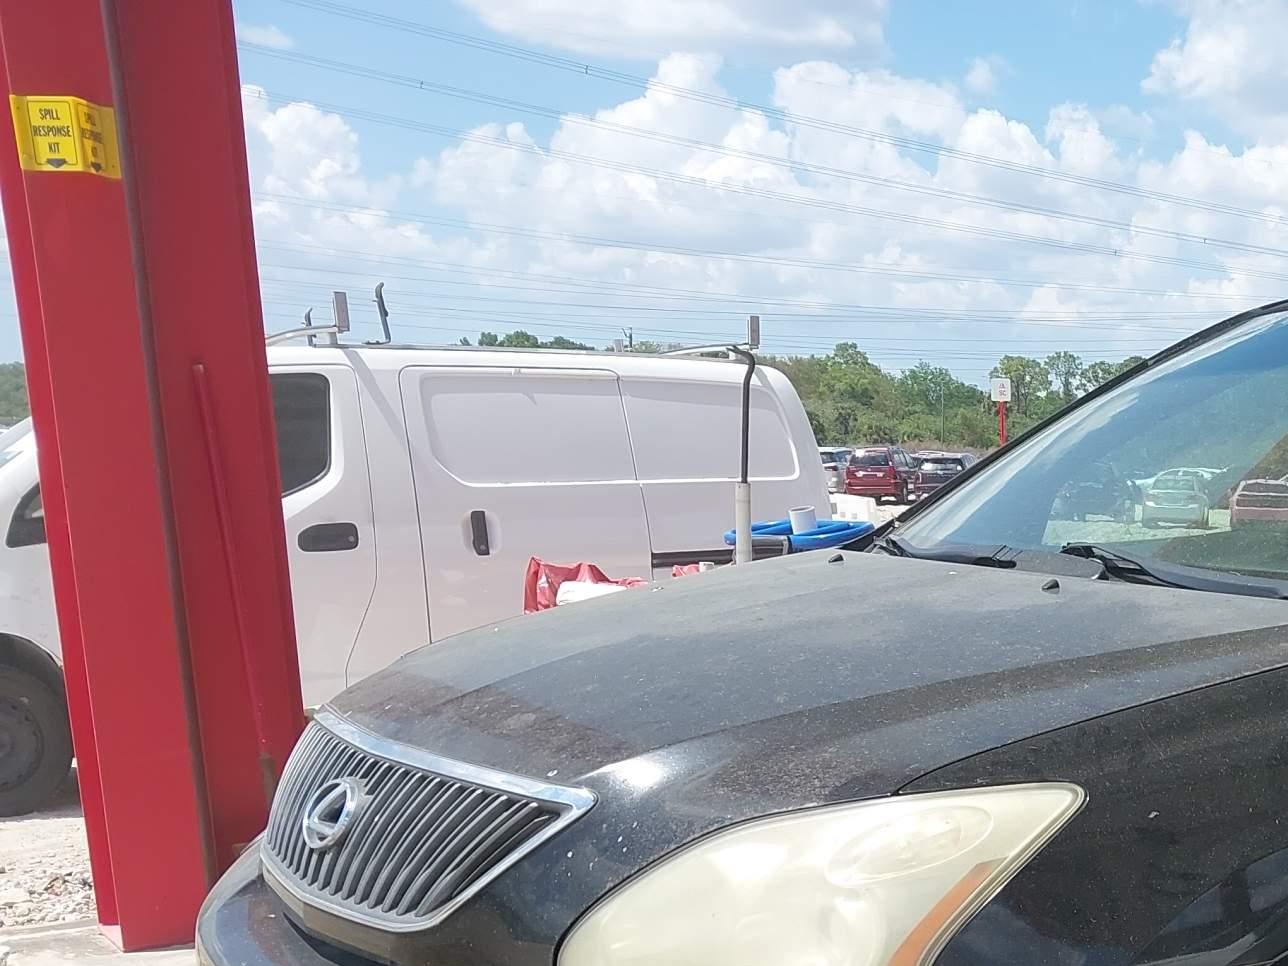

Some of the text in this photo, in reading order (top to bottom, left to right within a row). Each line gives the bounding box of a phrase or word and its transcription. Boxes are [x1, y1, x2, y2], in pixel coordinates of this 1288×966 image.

[39, 108, 60, 120] SPILL
[32, 125, 72, 137] RESPONSE
[48, 142, 60, 153] KIT
